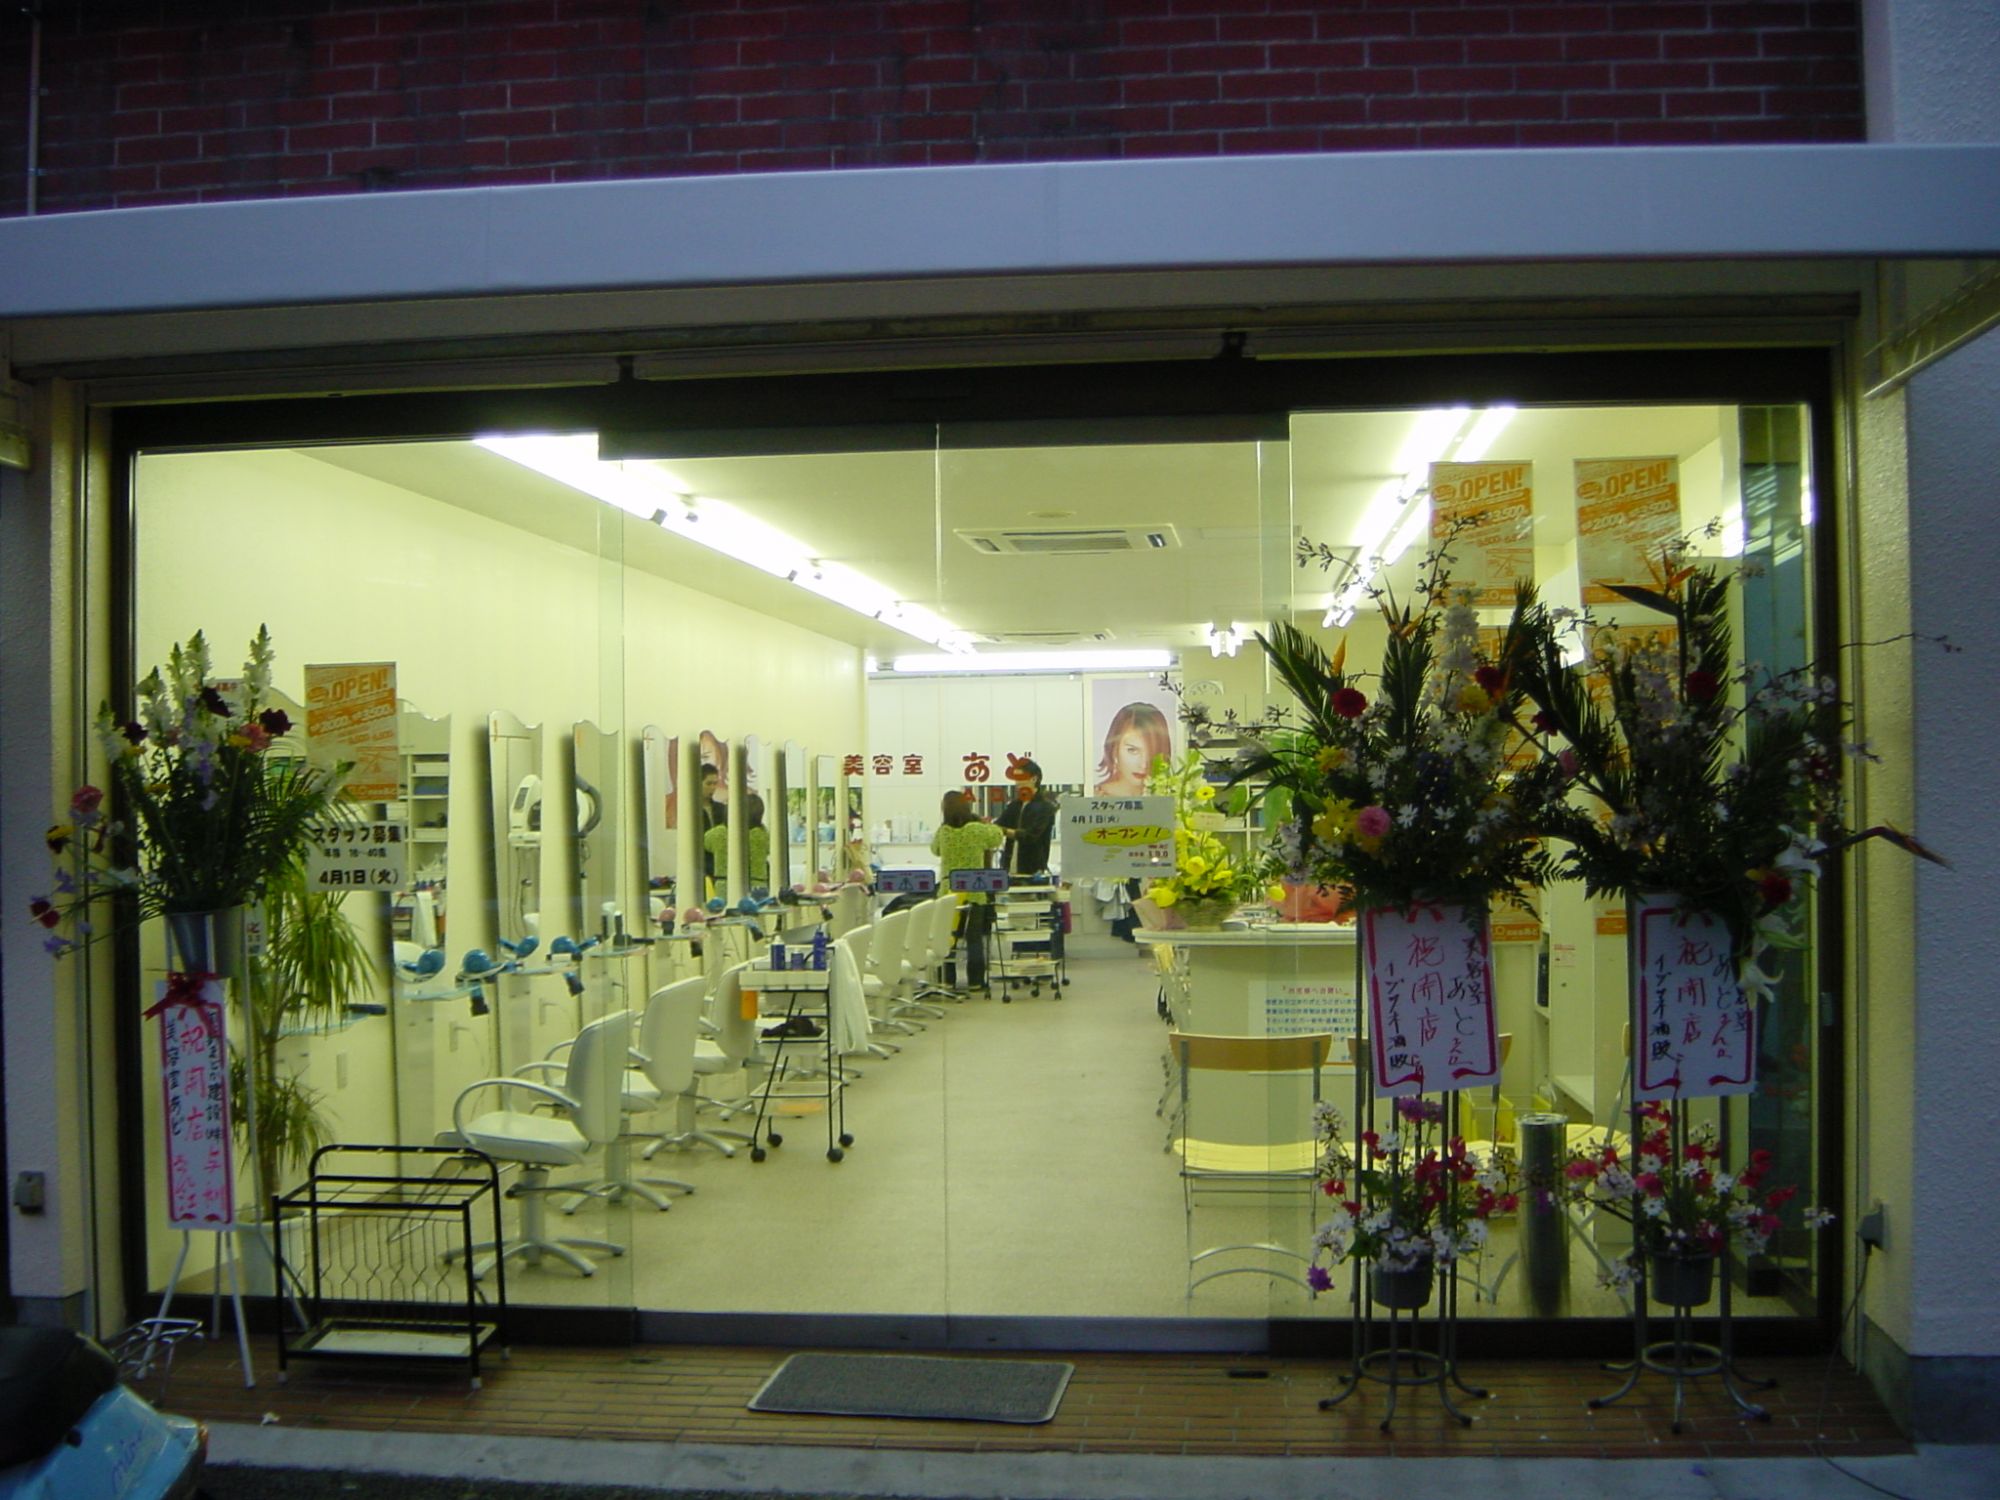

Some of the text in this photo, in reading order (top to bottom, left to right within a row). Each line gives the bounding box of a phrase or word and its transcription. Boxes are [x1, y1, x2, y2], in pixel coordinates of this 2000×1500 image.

[1459, 466, 1524, 500] OPEN!
[1605, 461, 1669, 497] OPEN!
[331, 668, 389, 702] OPEN!
[843, 751, 1032, 783] 美容室 あど
[1090, 800, 1144, 811] スタッフ募集
[312, 825, 401, 844] スタッフ募集
[319, 868, 399, 885] 4月1日(火)
[1408, 935, 1445, 1047] 祝開店
